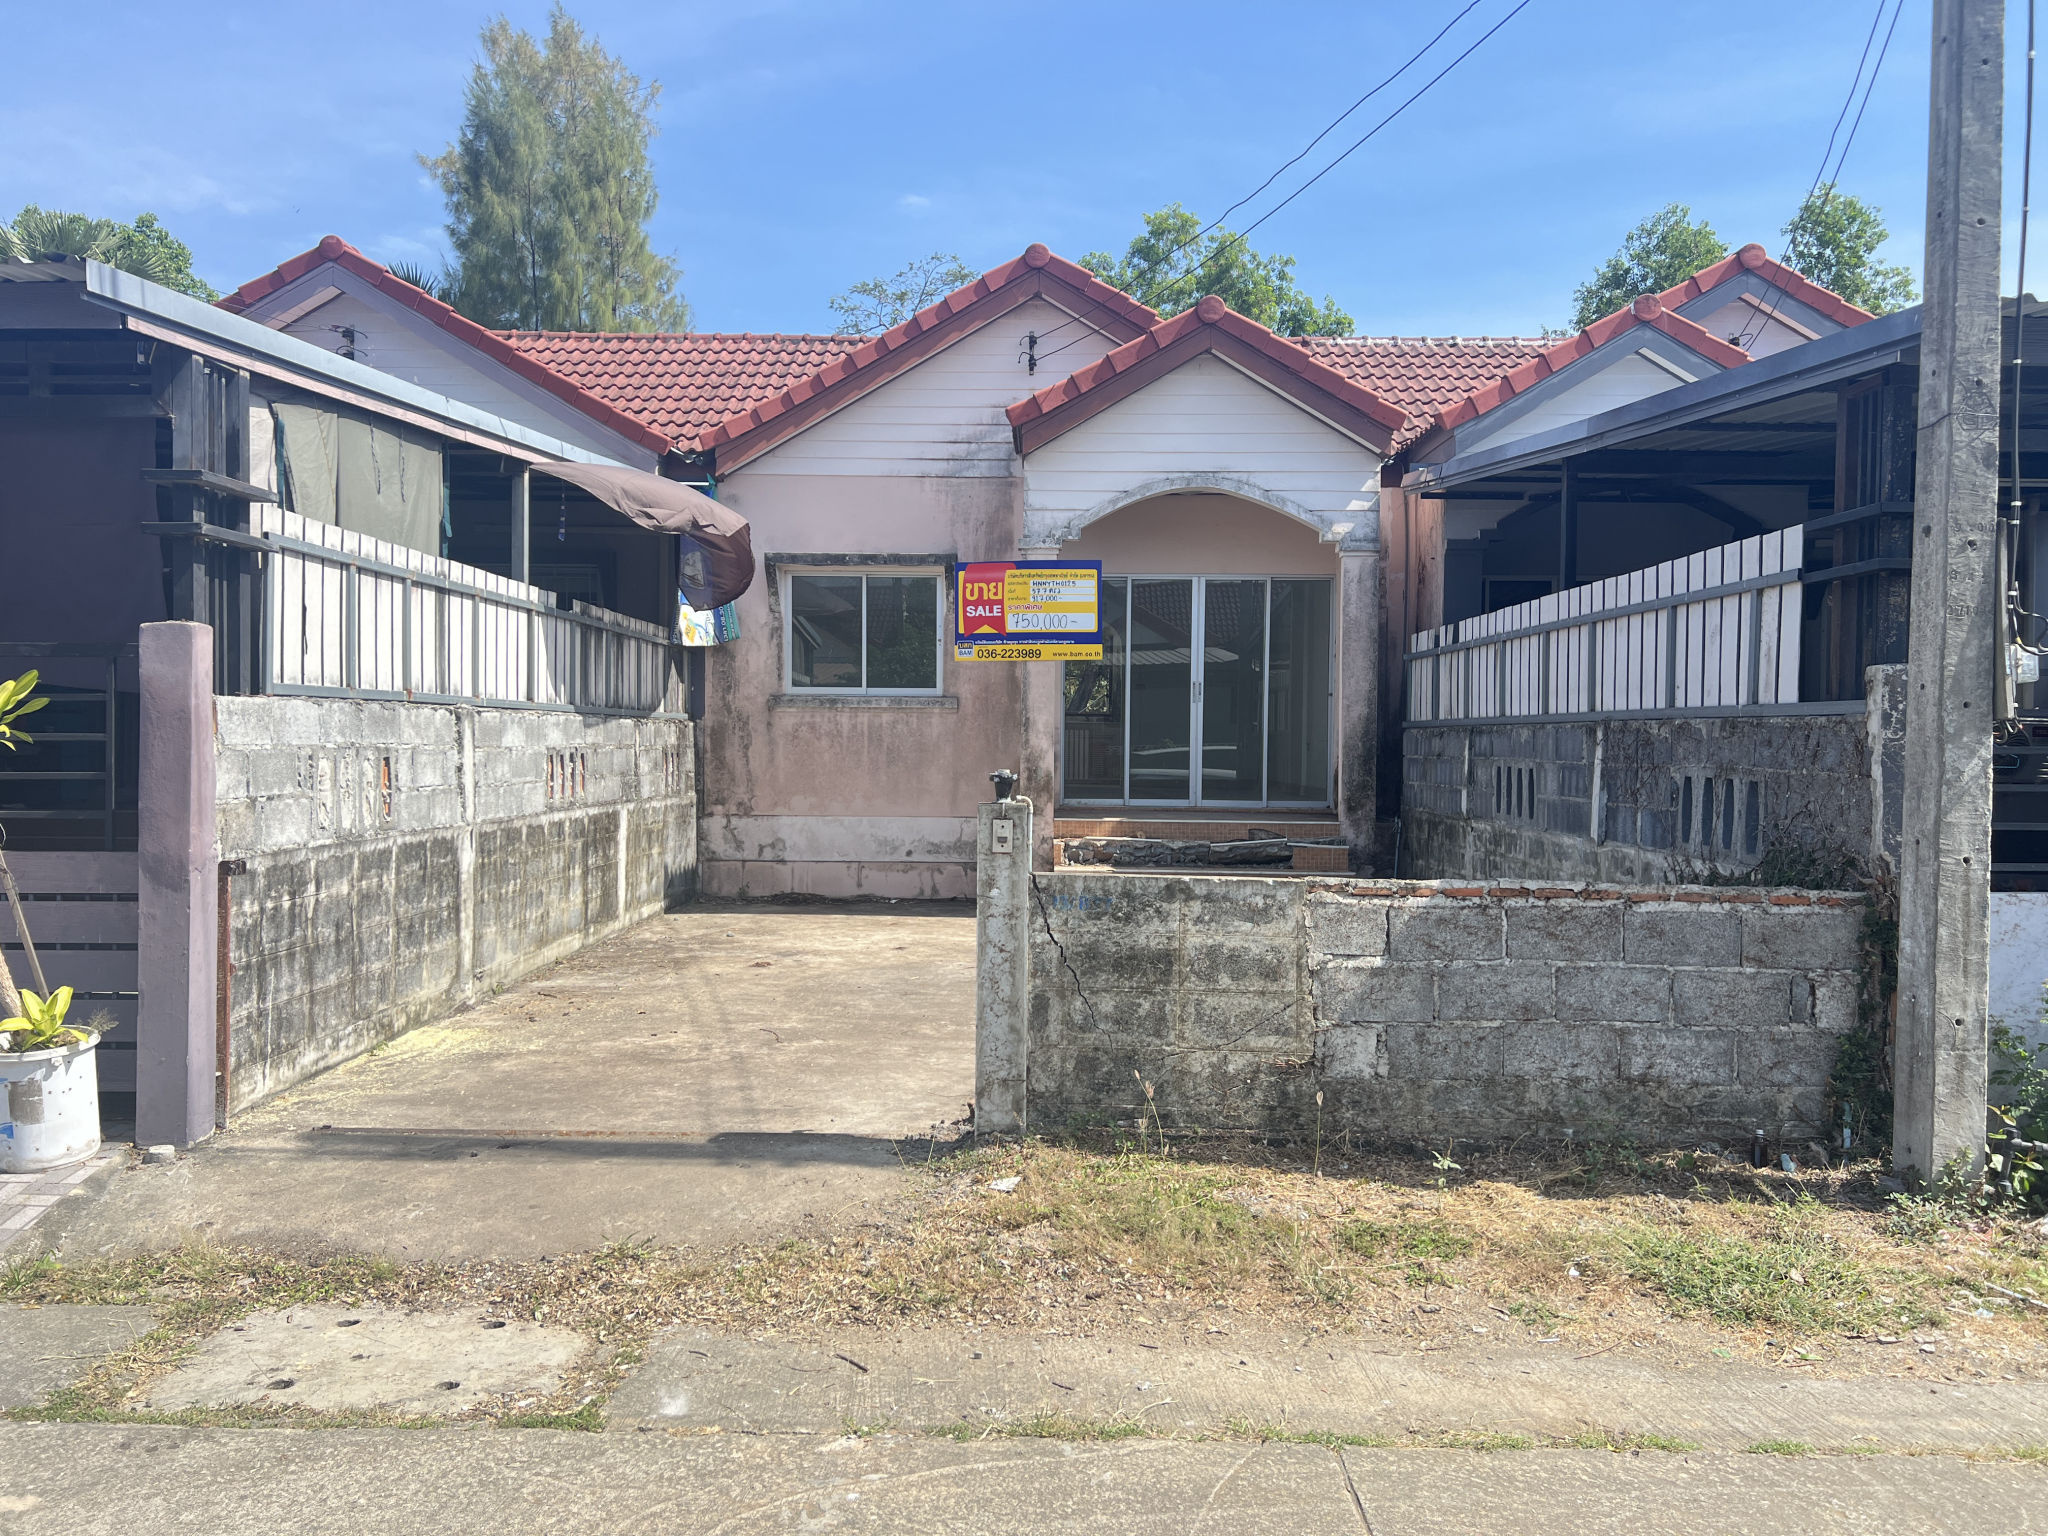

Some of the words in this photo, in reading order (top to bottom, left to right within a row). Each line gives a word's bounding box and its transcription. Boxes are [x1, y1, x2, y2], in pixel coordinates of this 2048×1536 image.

[966, 582, 1002, 600] ขาย
[967, 605, 1002, 616] SALE
[977, 648, 1041, 658] 036-223989
